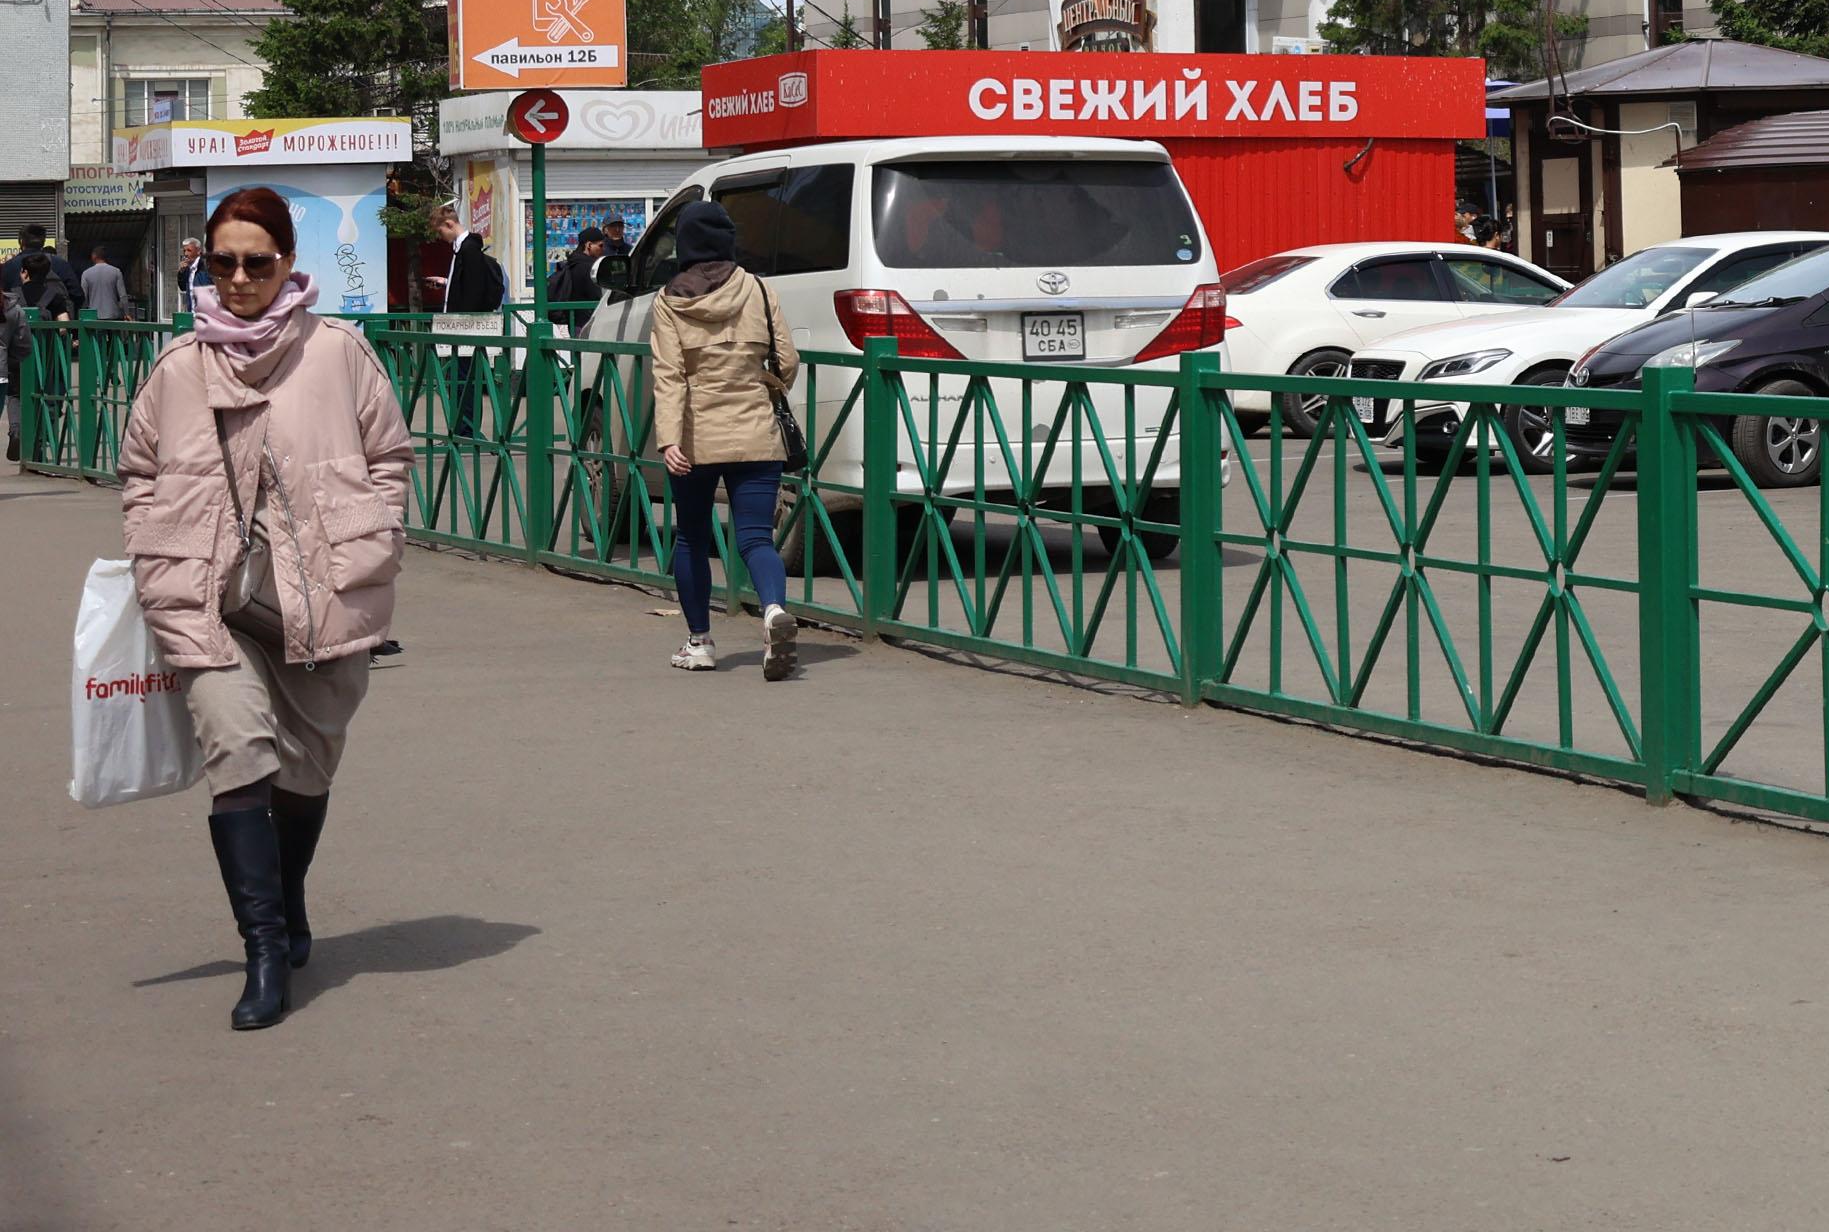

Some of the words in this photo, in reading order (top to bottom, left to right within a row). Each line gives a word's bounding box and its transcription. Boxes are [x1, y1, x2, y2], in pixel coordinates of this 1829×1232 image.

[491, 52, 562, 64] павильон
[568, 50, 597, 63] 12Б
[708, 88, 749, 119] СВЕЖИЙ
[750, 90, 775, 115] ХЛЕБ
[968, 68, 1209, 122] СВЕЖИЙ
[1225, 80, 1359, 122] ХЛЕБ
[188, 135, 225, 154] УРА!
[283, 133, 399, 152] МОРОЖЕНОЕ!!!
[63, 184, 124, 195] ОТОСТУДИЯ
[64, 197, 127, 208] КОПИЦЕНТР
[1030, 320, 1050, 336] 40
[1056, 319, 1077, 336] 45
[1038, 339, 1066, 352] СБА
